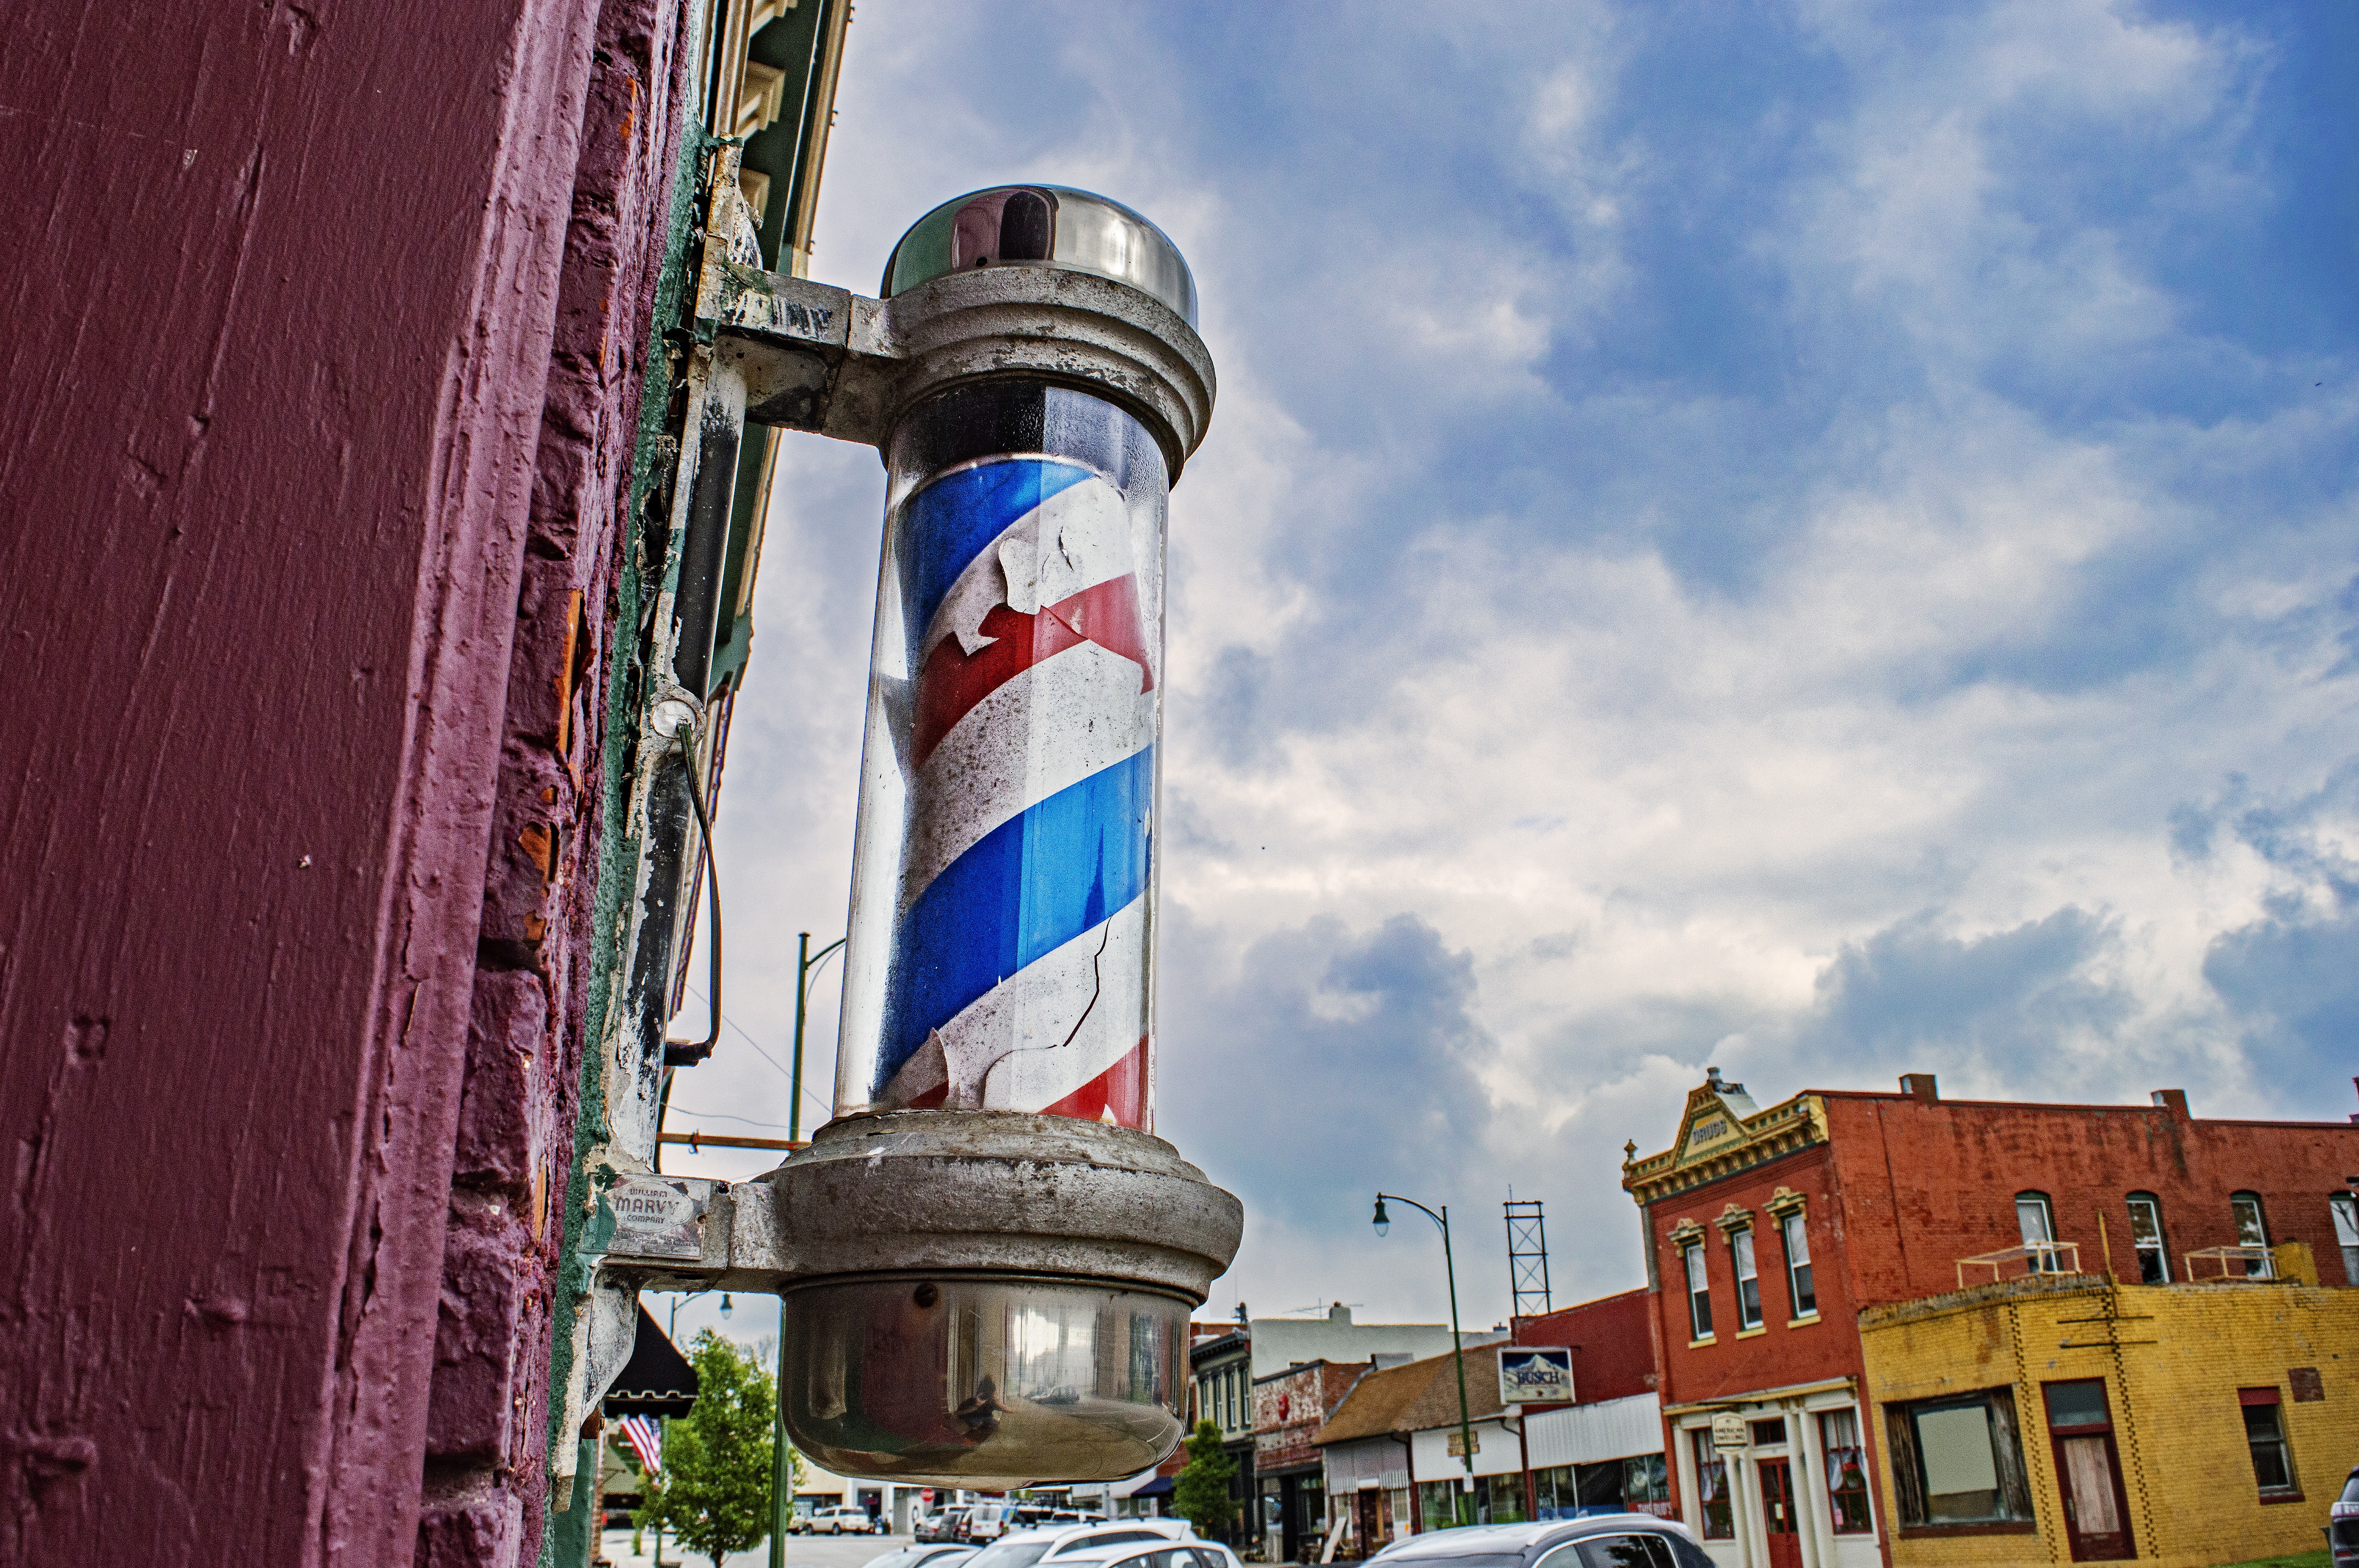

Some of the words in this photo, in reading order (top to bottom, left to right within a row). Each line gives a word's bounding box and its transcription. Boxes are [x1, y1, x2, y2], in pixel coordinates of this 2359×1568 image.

[630, 1188, 667, 1197] WILLIAM
[616, 1197, 680, 1215] MARVY
[627, 1215, 665, 1224] COMPANY
[1518, 1371, 1560, 1385] BUSCH
